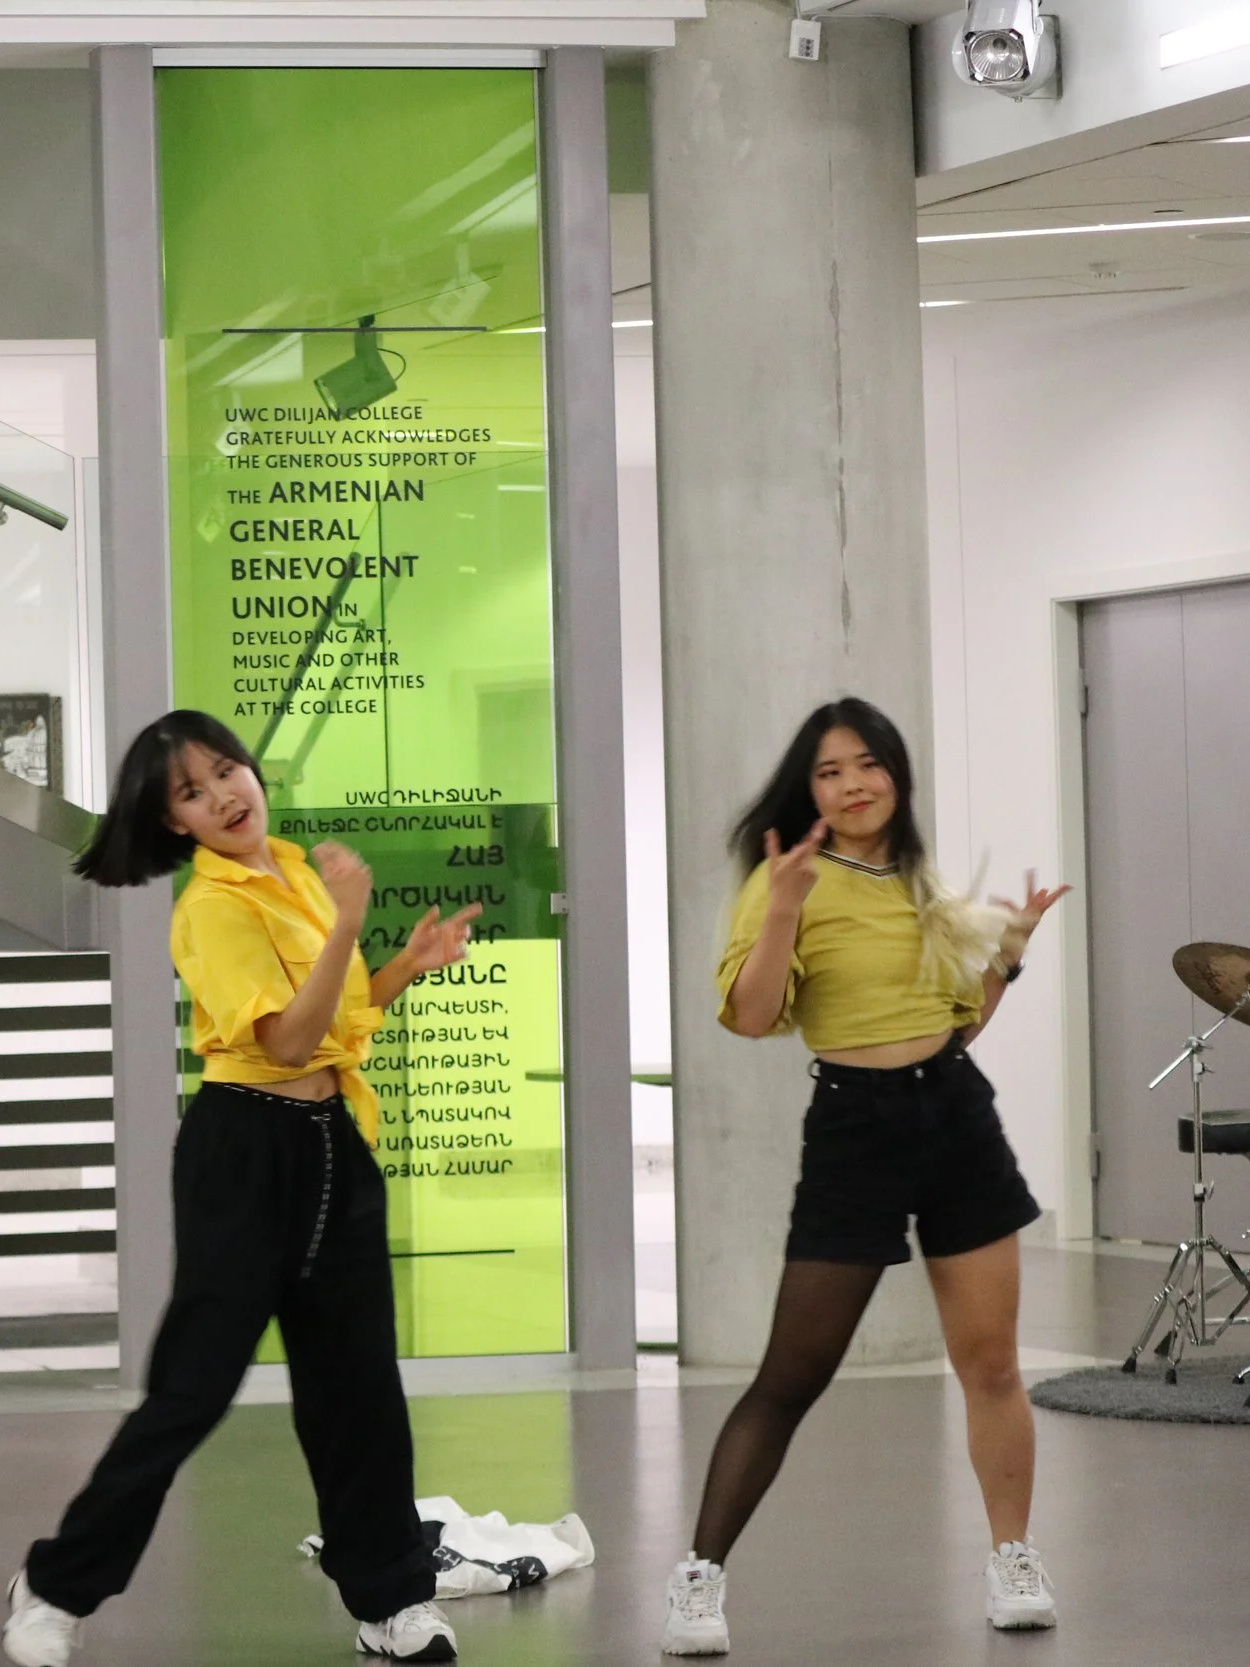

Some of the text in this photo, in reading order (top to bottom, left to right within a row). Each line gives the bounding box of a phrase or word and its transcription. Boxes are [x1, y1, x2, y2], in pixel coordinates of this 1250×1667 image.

[225, 406, 422, 425] UWC DILIJAN COLLEGE
[226, 429, 491, 445] GRATEFULLY ACKNOWLEDGES
[228, 455, 259, 469] THE
[266, 454, 363, 468] GENEROUS
[368, 453, 447, 467] SUPPORT
[455, 452, 477, 465] OF
[228, 480, 424, 504] THE ARMENIAN
[230, 519, 359, 542] GENERAL
[232, 556, 418, 580] BENEVOLENT
[233, 596, 357, 618] UNION IN
[233, 630, 392, 645] DEVELOPING ART,
[234, 653, 399, 669] MUSIC AND OTHER
[234, 675, 424, 692] CULTURAL ACTIVITIES
[234, 700, 377, 716] AT THE COLLEGE
[393, 788, 501, 803] ԴԻԼԻՋԱՆԻ
[280, 815, 503, 834] ՔՈԼԵՋԸ ՇՆՈՐՀԱԿԱԼ Է
[447, 844, 504, 867] ՀԱՅ
[372, 1026, 509, 1044] ՇՏՈՒԹՅԱՆ ԵՎ
[371, 1080, 510, 1097] ՈՒՆԵՈՒԹՅԱՆ
[402, 1107, 511, 1123] ՆՊԱՏԱԿՈՎ
[387, 1133, 512, 1150] ԱՌԱՏԱՁԵՌՆ
[445, 1159, 513, 1175] ՀԱՄԱՐ
